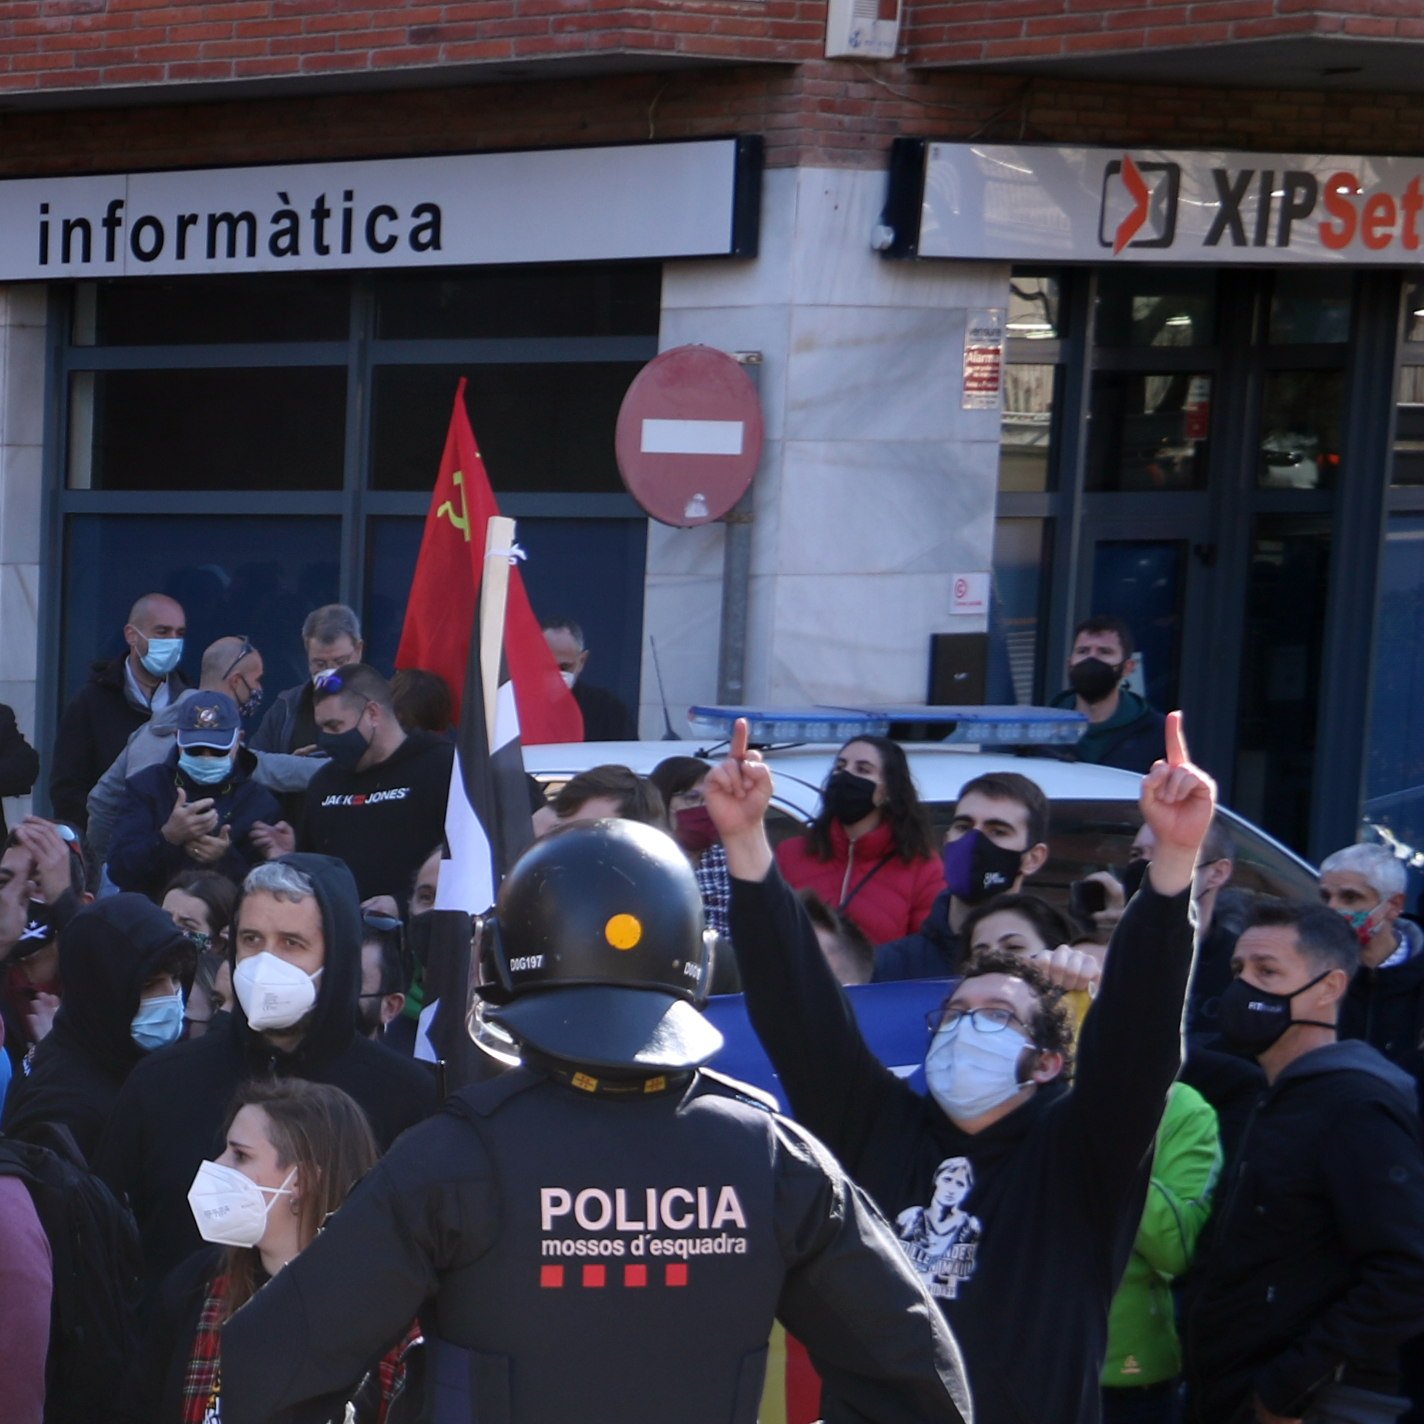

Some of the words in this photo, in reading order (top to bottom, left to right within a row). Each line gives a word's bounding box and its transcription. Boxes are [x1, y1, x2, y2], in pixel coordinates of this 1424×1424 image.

[39, 189, 443, 266] informàtica
[1202, 168, 1424, 250] XIPSet
[539, 1185, 747, 1231] POLICIA
[541, 1238, 625, 1257] mossos
